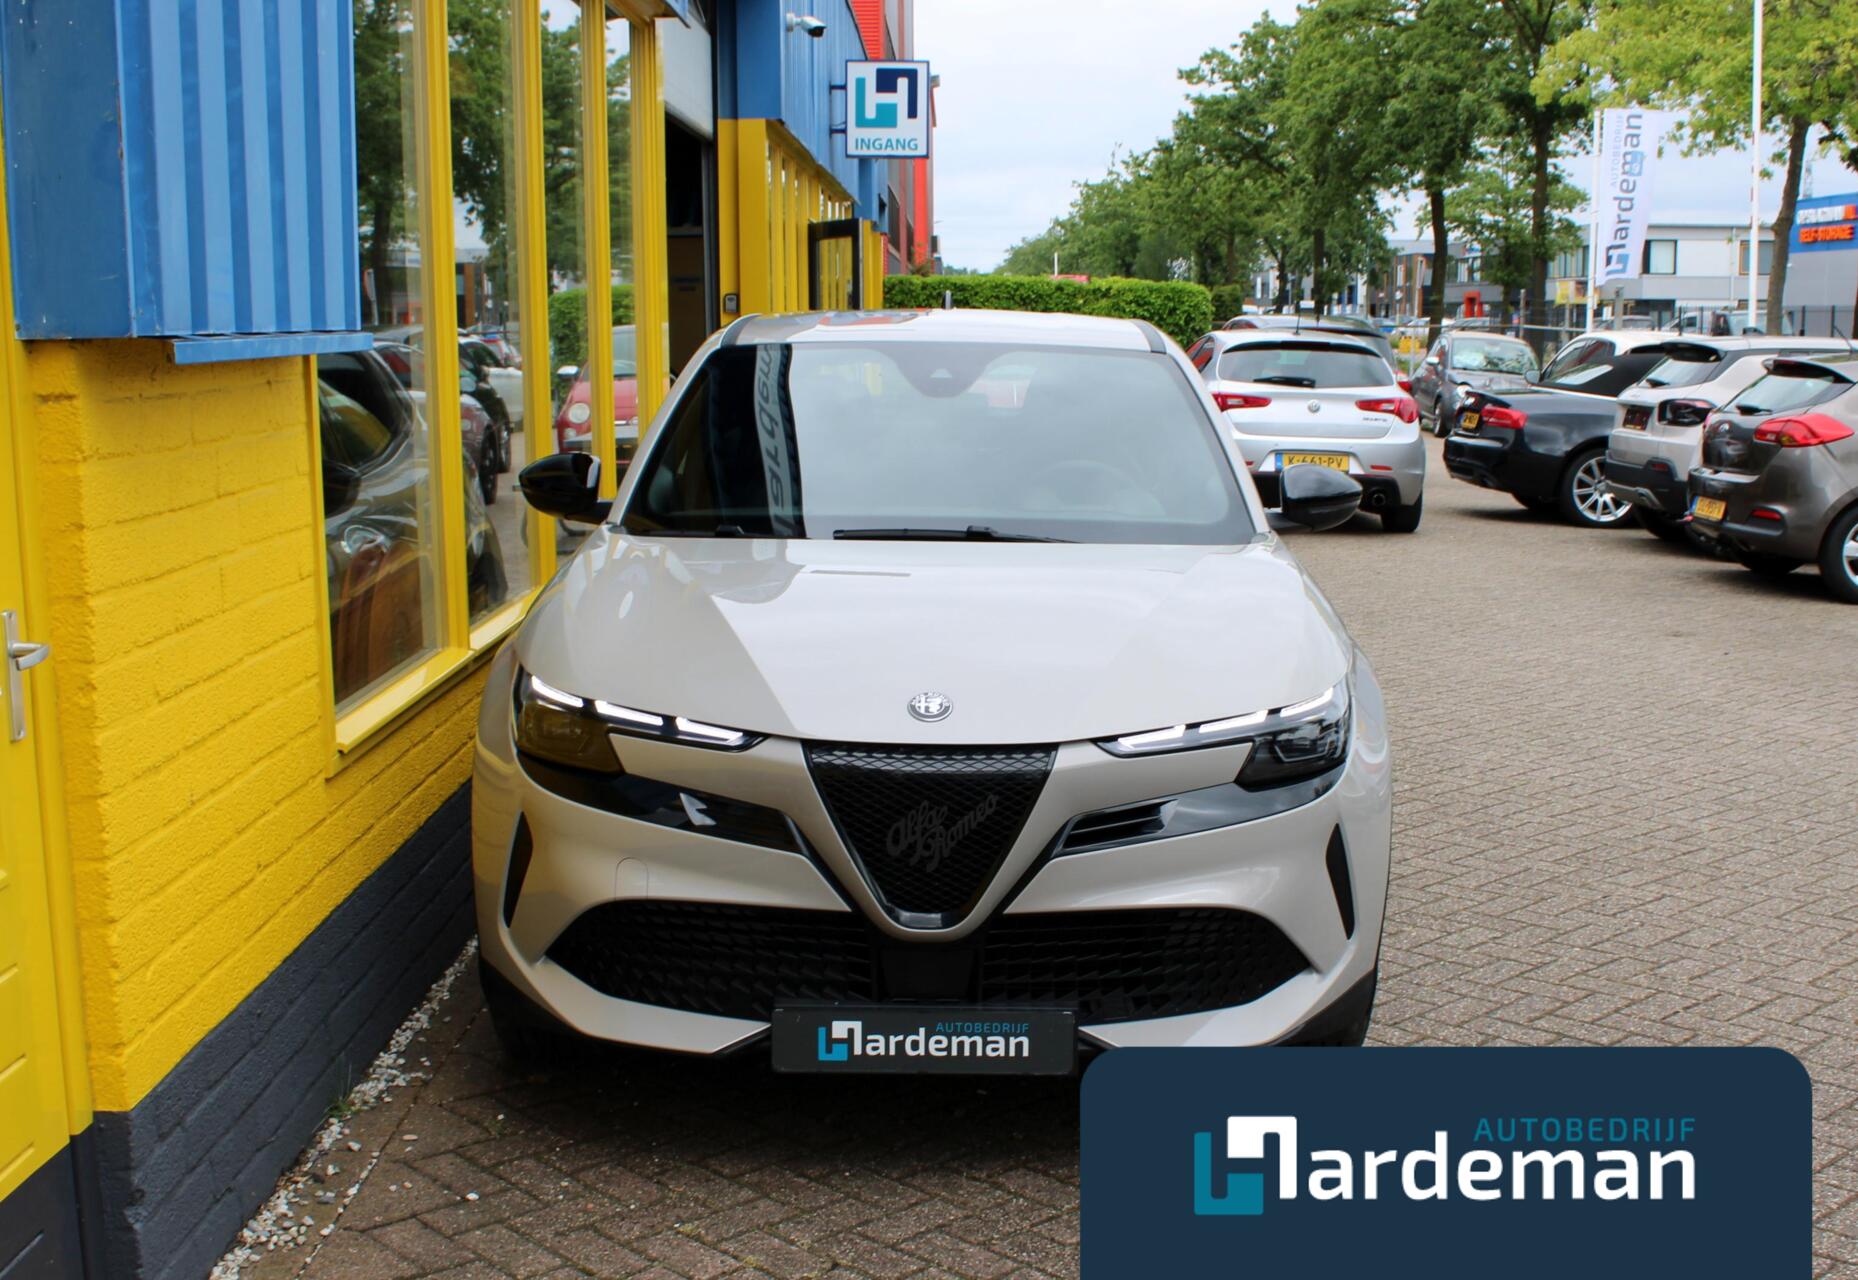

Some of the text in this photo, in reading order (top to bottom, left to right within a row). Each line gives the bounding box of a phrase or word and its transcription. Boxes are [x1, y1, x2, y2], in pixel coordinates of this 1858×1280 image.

[855, 138, 919, 151] INGANG
[886, 799, 948, 867] Alfa
[919, 794, 1000, 873] Romeo
[818, 1020, 1030, 1062] Hardeman
[936, 1022, 1030, 1034] AUTOBEDRIJF
